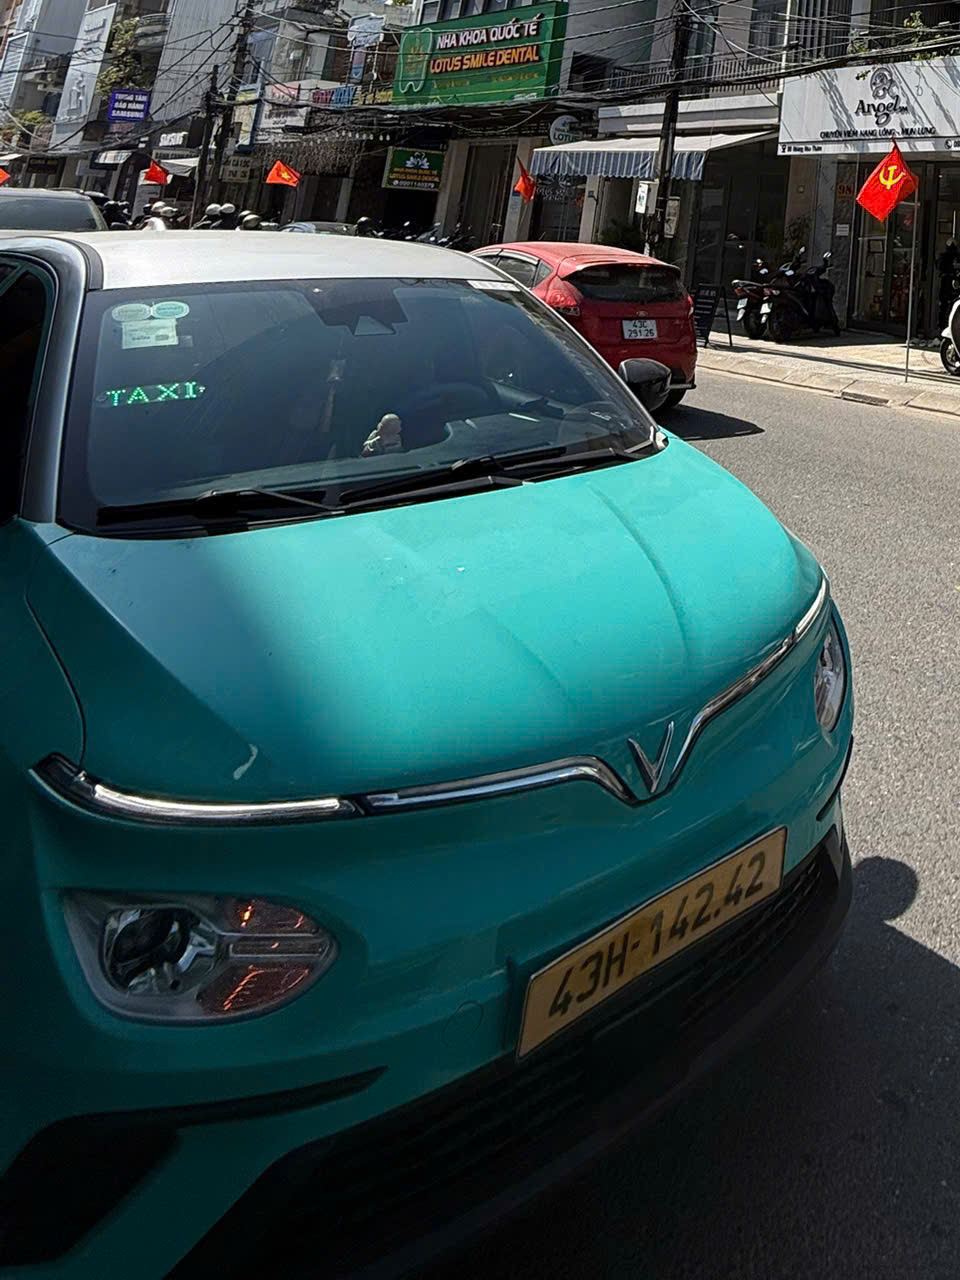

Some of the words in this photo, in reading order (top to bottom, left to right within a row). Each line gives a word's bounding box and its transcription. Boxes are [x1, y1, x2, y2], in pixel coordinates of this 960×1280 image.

[436, 33, 457, 49] NHA
[459, 28, 487, 46] KHOA
[490, 18, 521, 42] QUỐC
[430, 55, 462, 73] LOTUS
[462, 51, 496, 70] SMILE
[496, 45, 539, 66] DENTAL
[854, 95, 900, 128] Angel
[632, 320, 648, 328] 43C
[106, 381, 198, 407] TAXI
